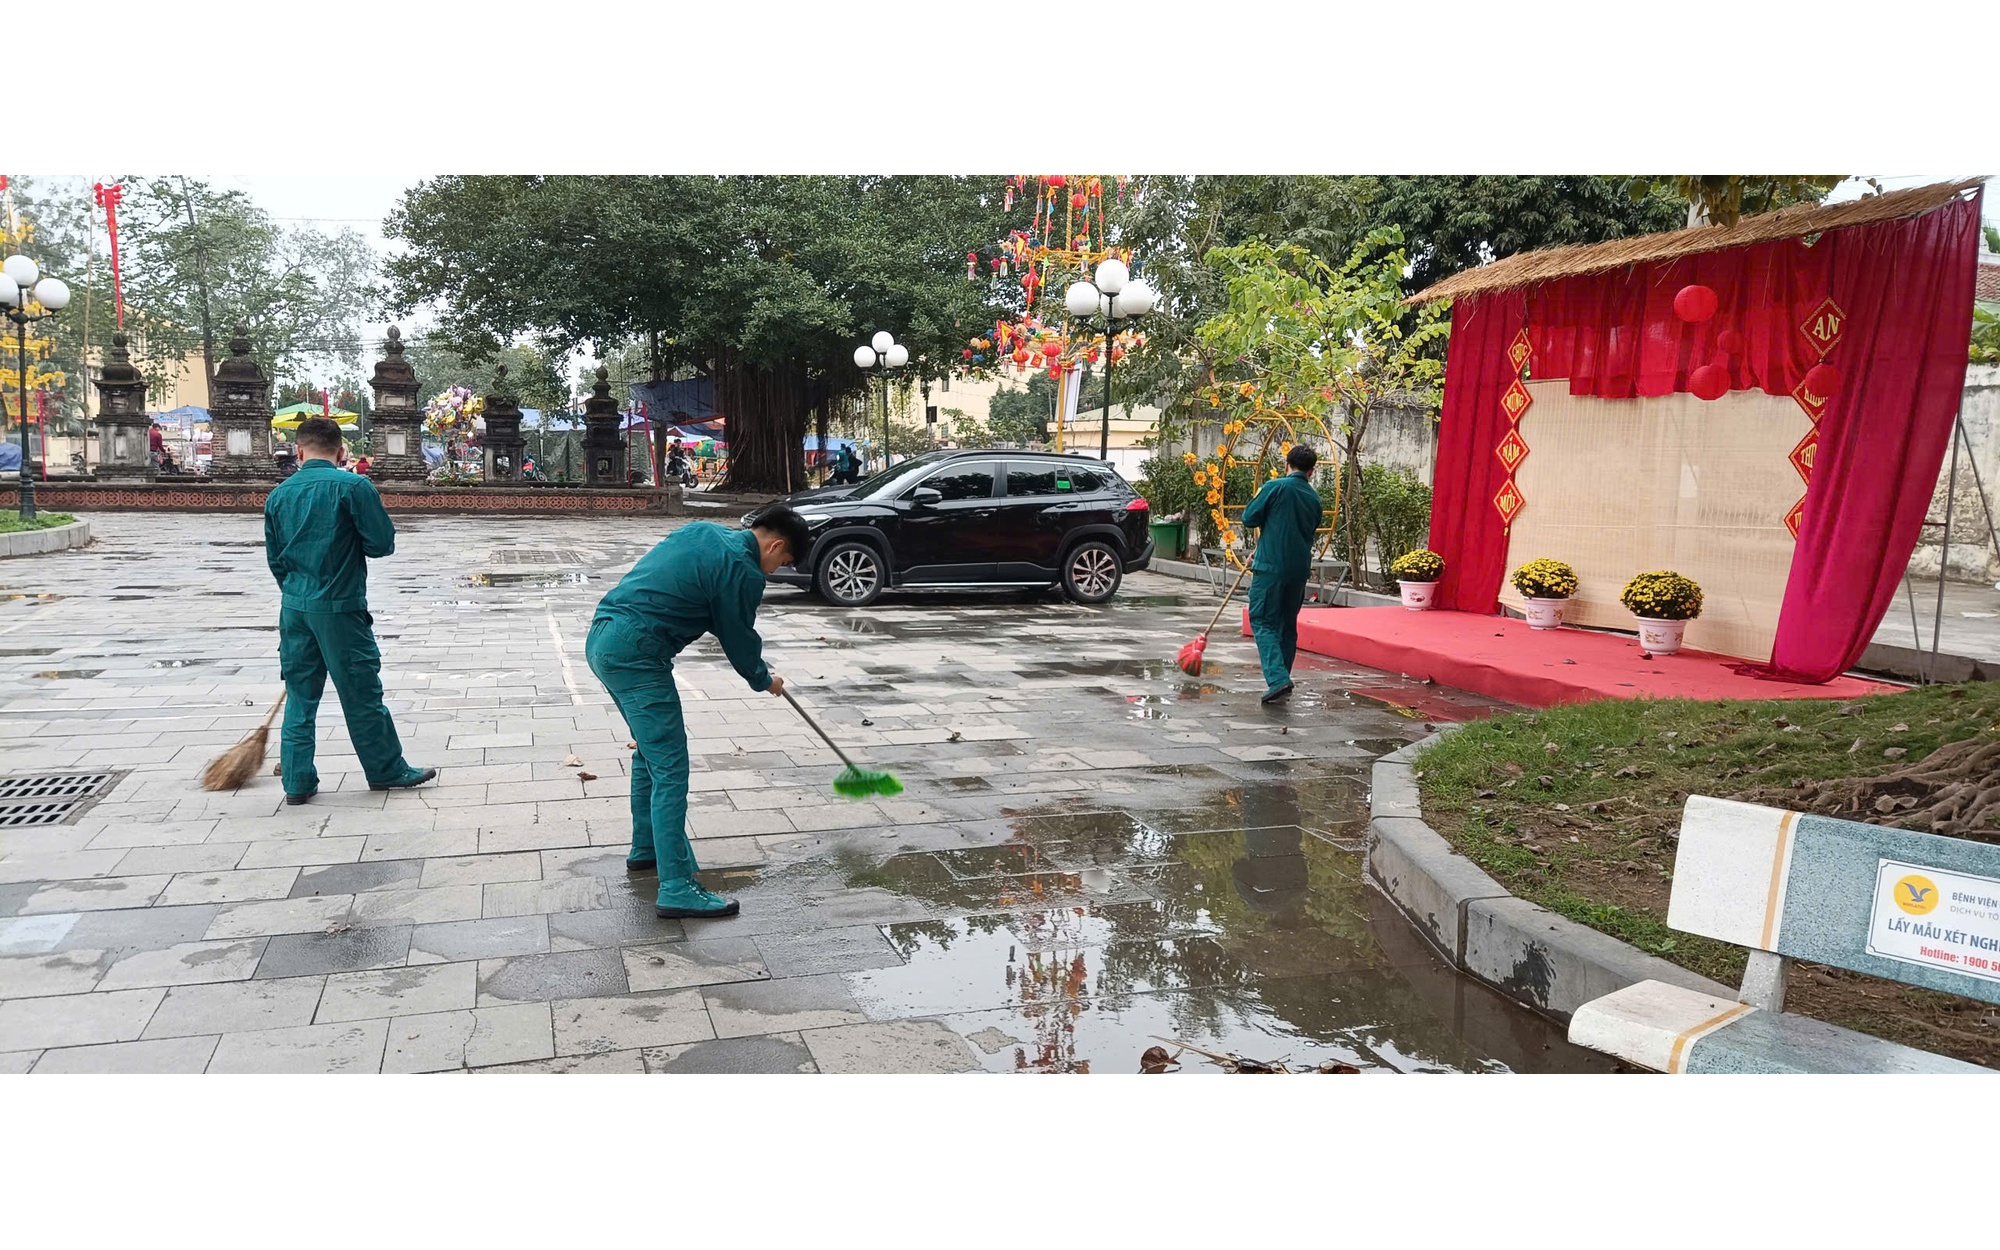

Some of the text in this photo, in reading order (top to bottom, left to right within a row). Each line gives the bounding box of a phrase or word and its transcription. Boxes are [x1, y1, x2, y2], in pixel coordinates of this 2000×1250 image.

[1812, 313, 1840, 341] AN
[1952, 892, 1998, 909] BỆNH VIỆN
[1888, 917, 2000, 952] LẤY MẪU XÉT NGH
[1920, 946, 1959, 963] Hotline:
[1963, 956, 1989, 969] 1900
